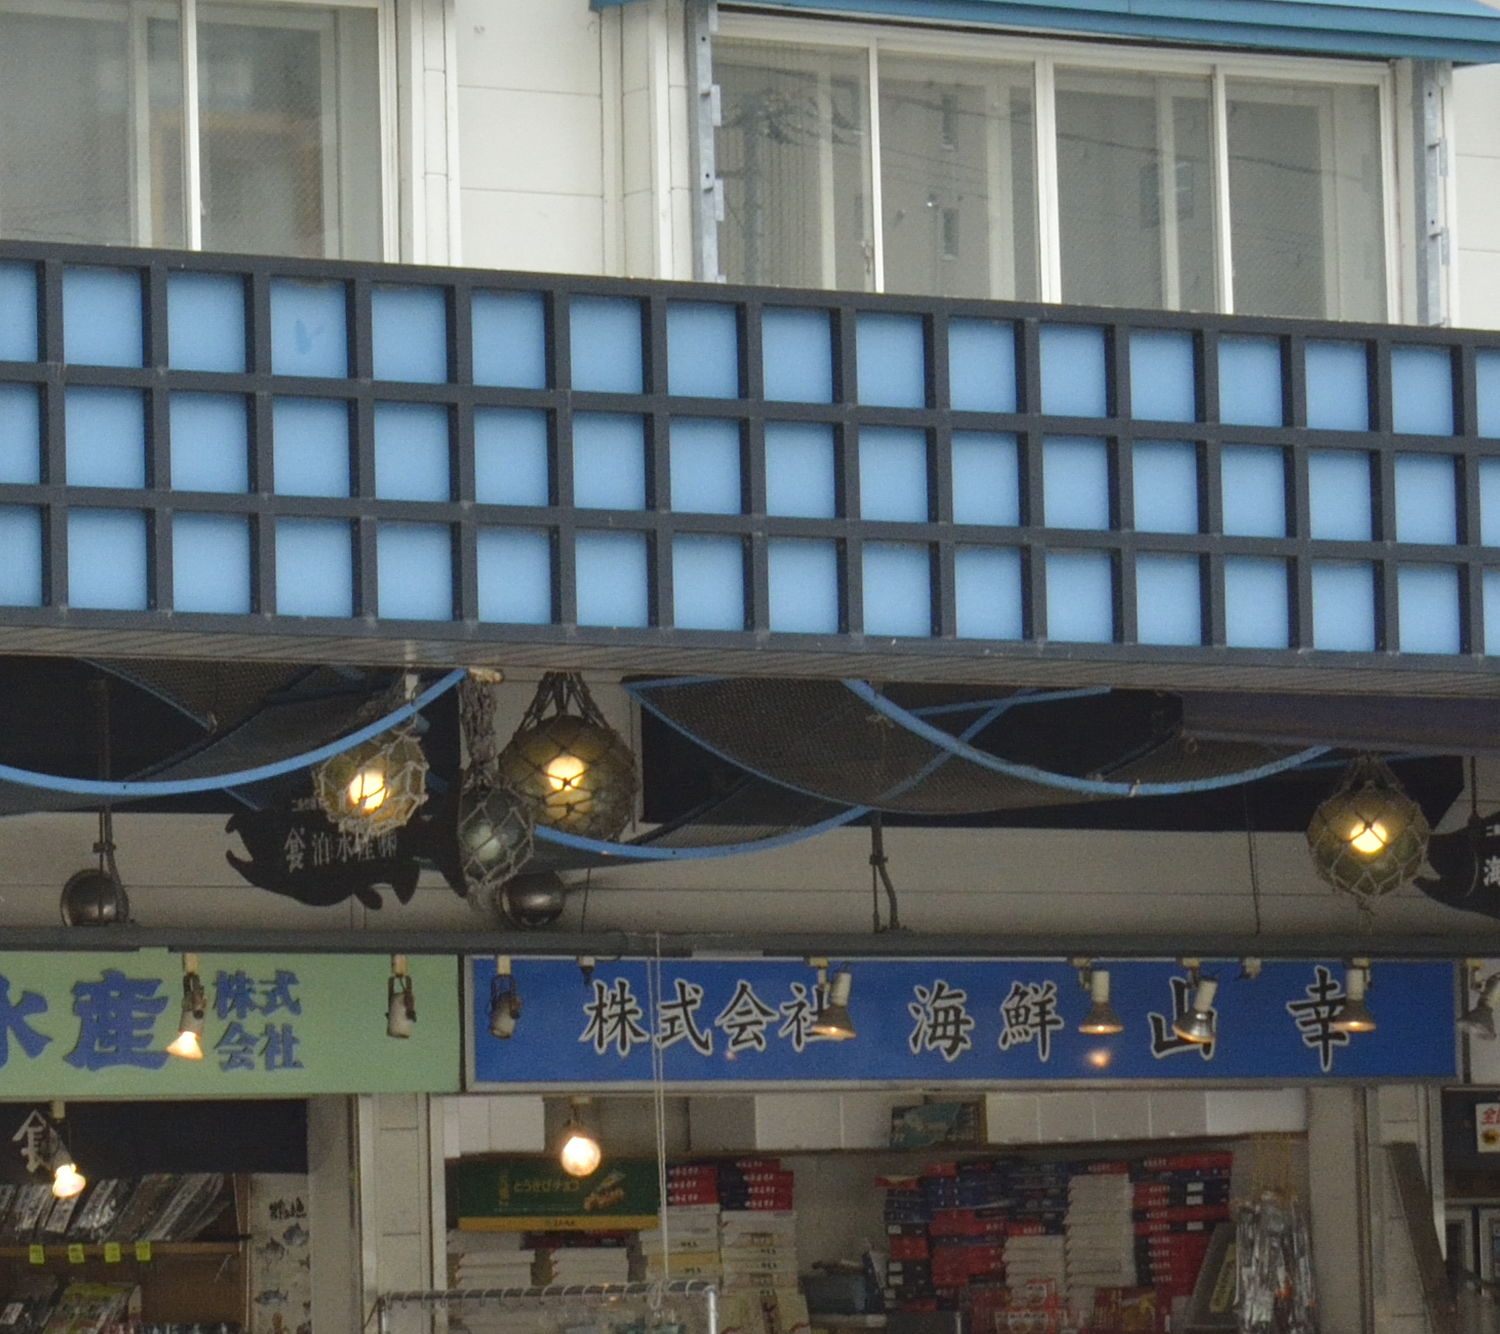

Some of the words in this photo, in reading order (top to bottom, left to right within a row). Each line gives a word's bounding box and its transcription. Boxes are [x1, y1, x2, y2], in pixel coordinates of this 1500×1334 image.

[213, 968, 302, 1020] 株式
[581, 975, 835, 1063] 株式会社
[906, 978, 1065, 1063] 海鮮
[213, 1021, 304, 1072] 会社
